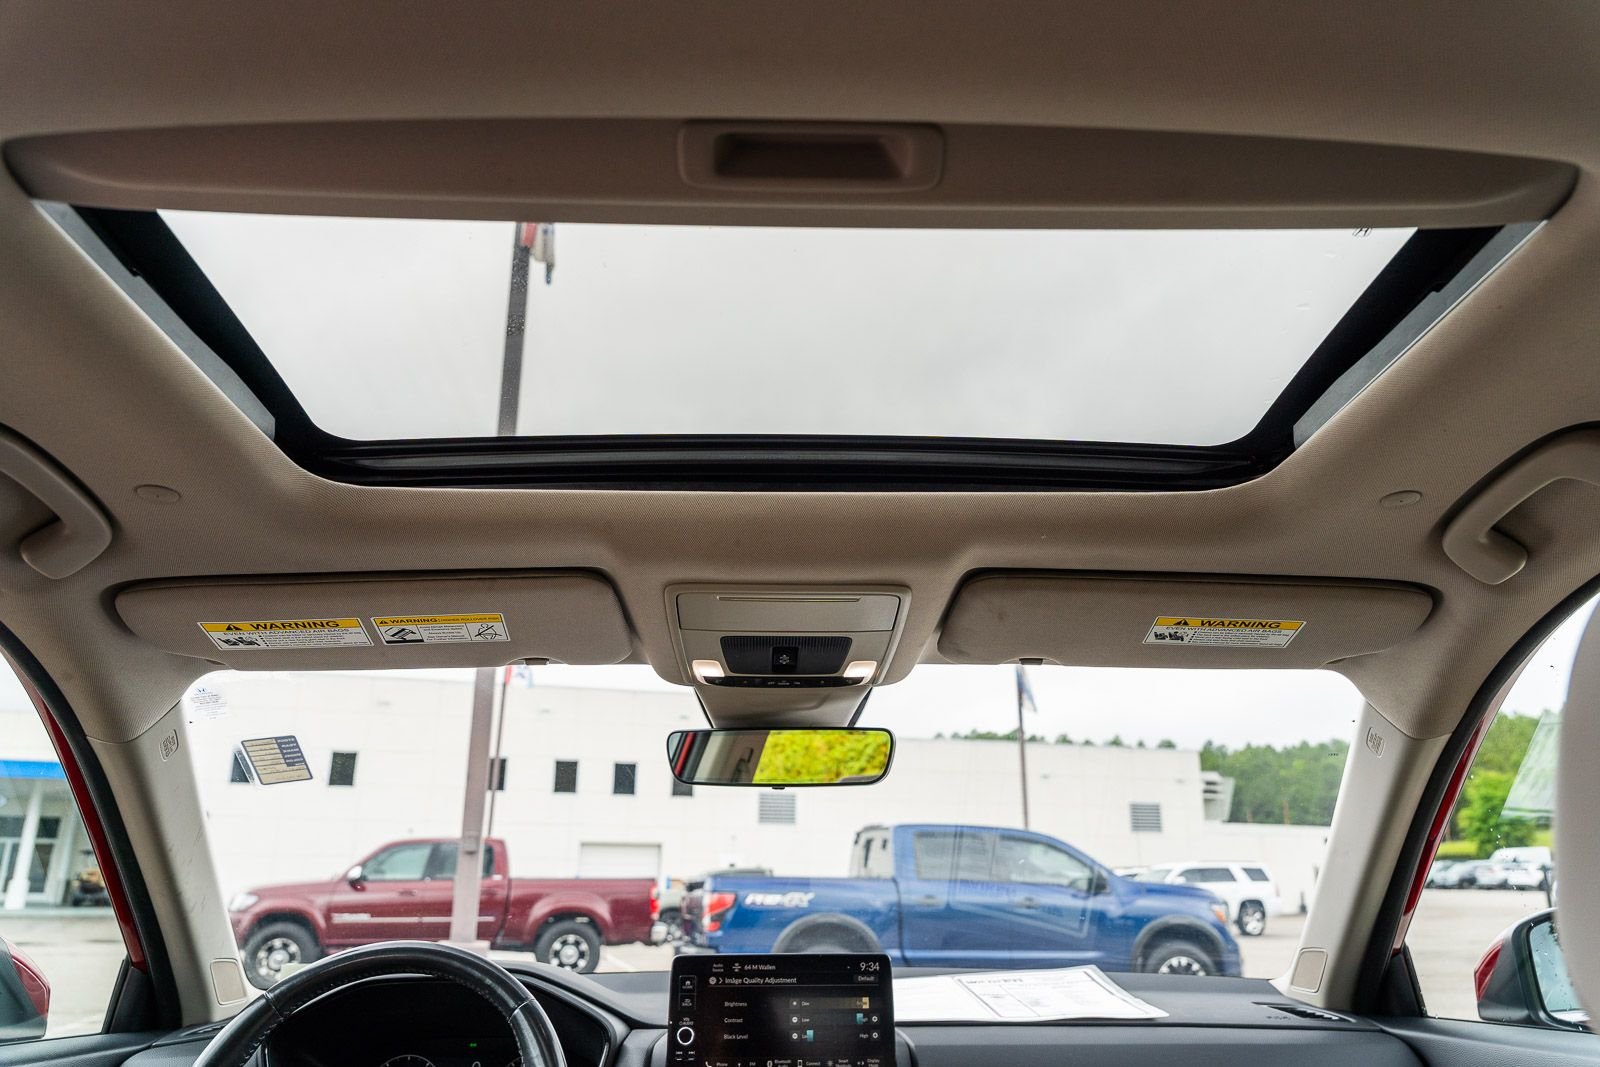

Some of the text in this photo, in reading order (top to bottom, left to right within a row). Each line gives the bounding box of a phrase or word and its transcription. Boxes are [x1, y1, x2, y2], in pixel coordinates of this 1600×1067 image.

[249, 620, 340, 630] WARNING
[1200, 620, 1281, 629] WARNING
[859, 961, 880, 972] 9:34
[724, 977, 797, 985] Image Quality Adjustment
